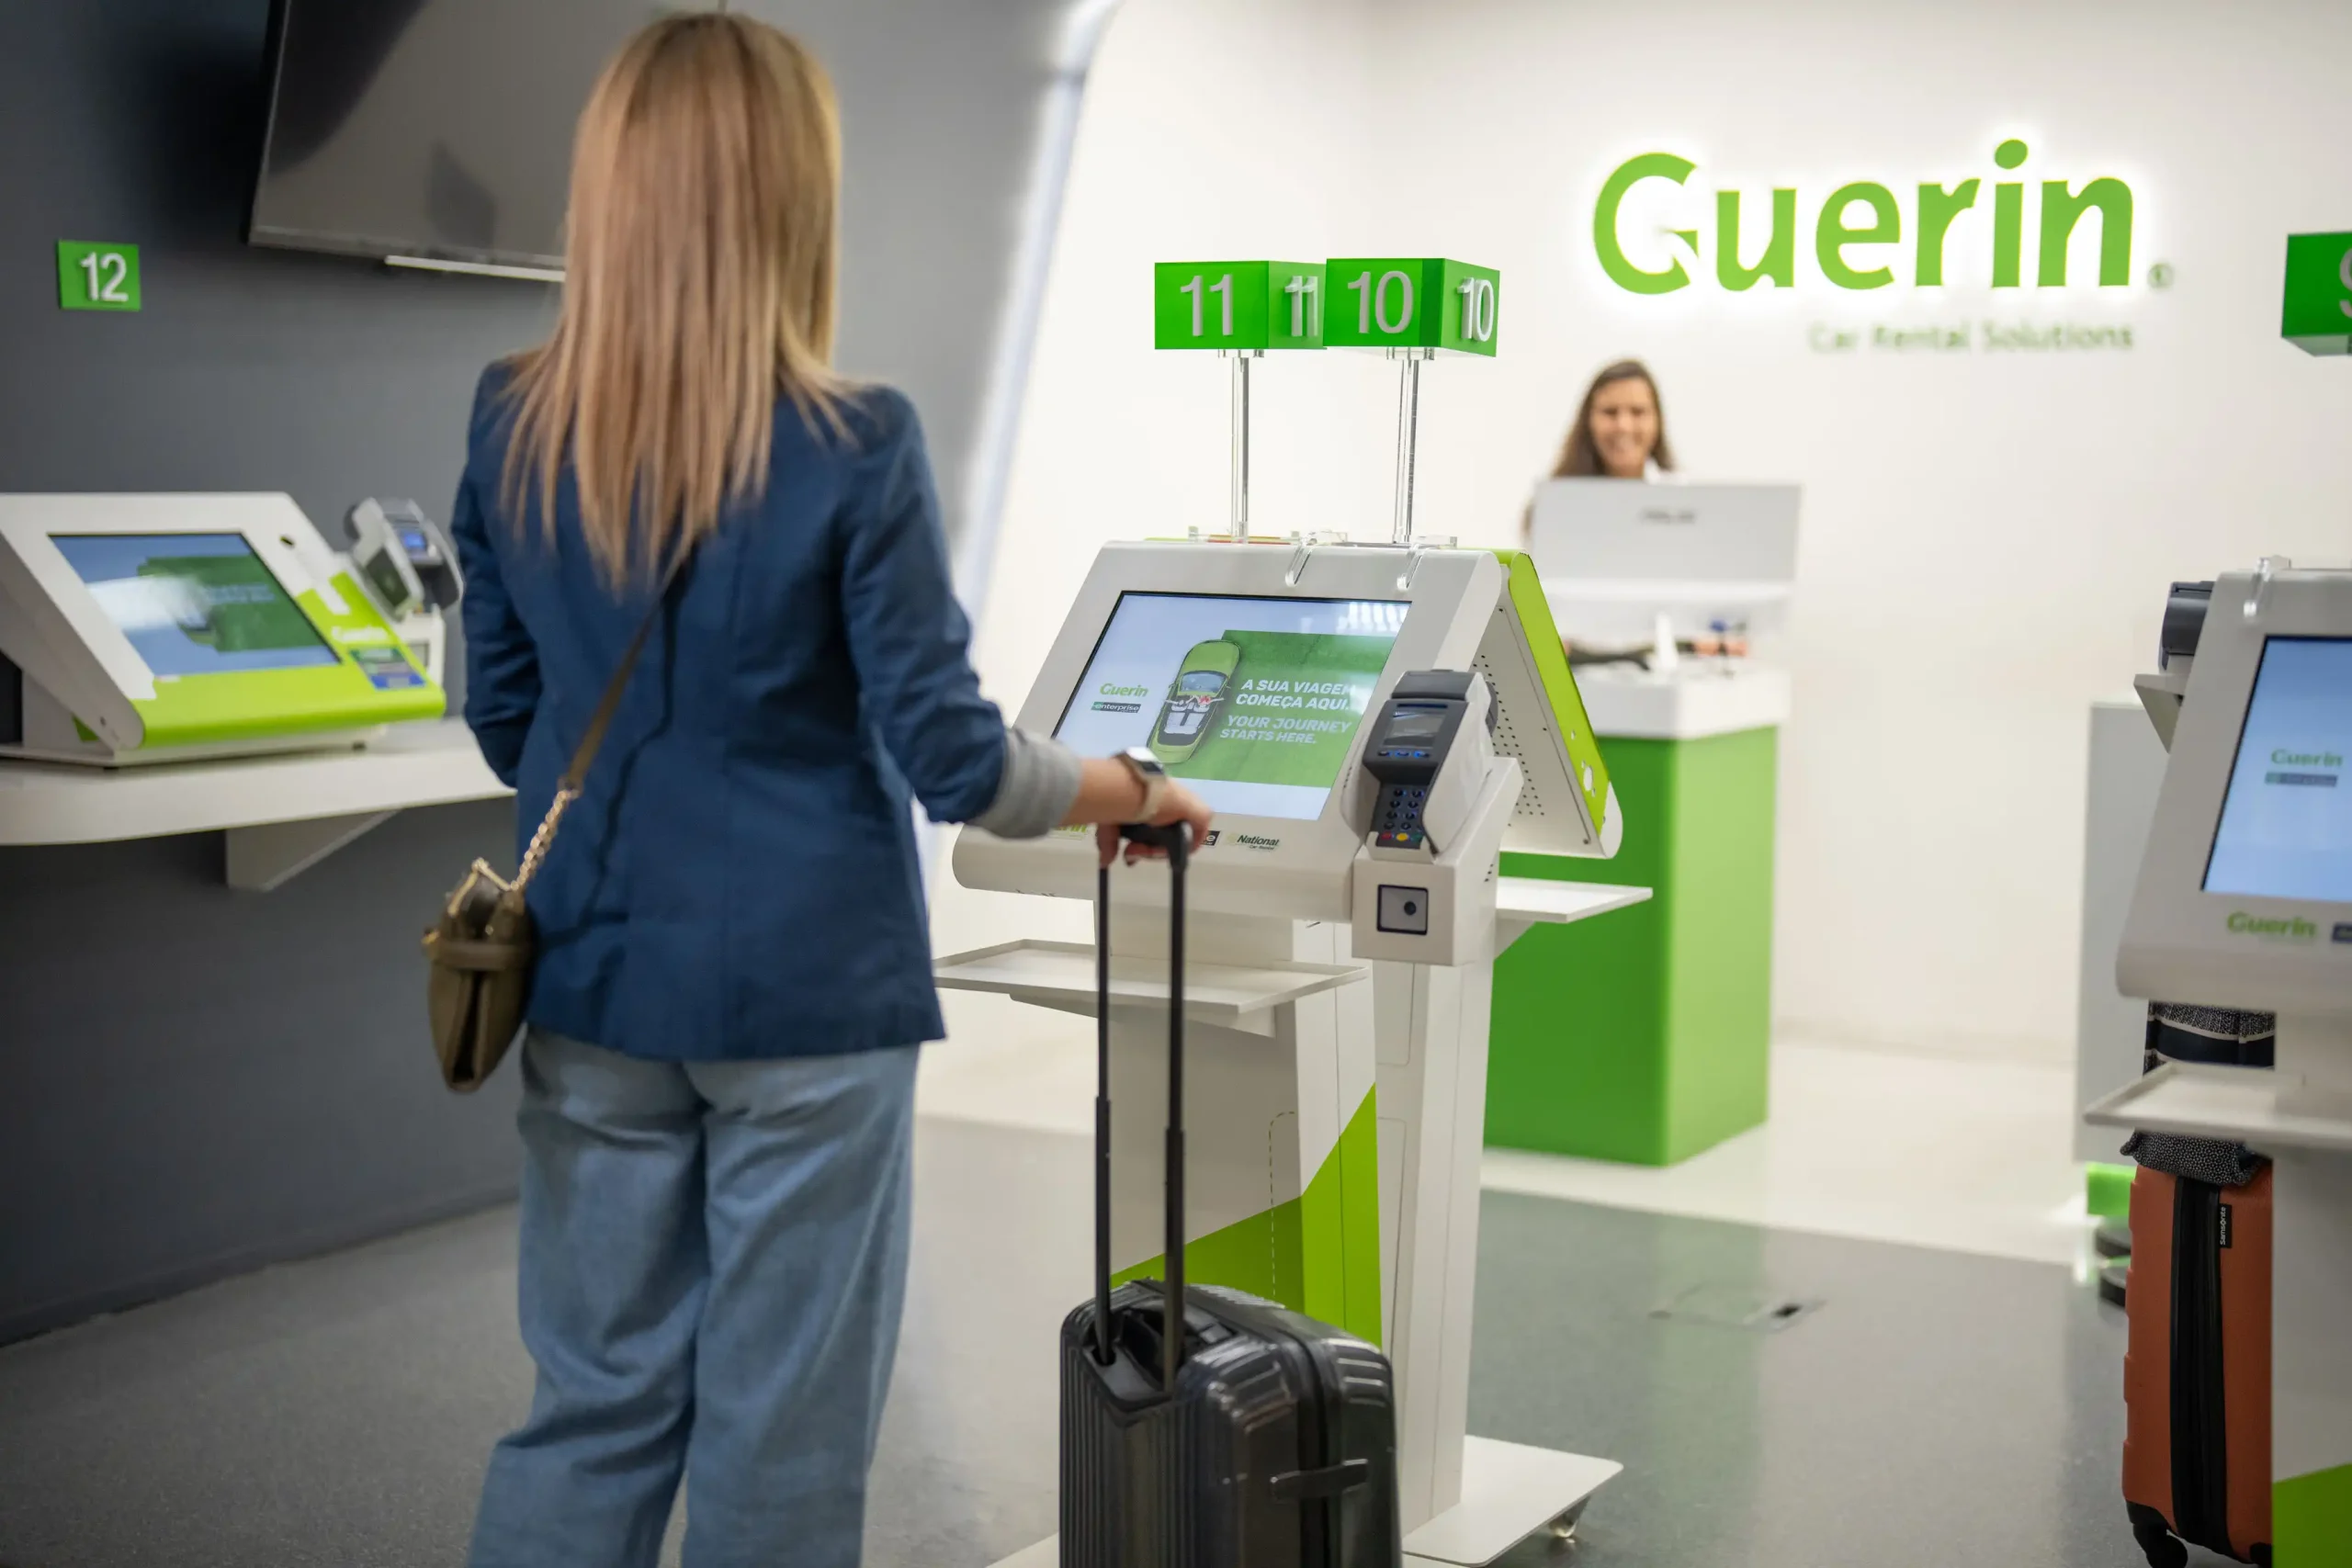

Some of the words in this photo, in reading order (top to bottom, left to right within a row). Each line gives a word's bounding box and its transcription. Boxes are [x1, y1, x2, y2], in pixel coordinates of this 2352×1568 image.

[1593, 139, 2133, 295] Guerin
[80, 252, 129, 301] 12
[1180, 274, 1234, 336] 11
[1284, 276, 1318, 337] 11
[1347, 270, 1414, 334] 10
[1457, 276, 1495, 343] 10
[1873, 321, 1969, 352] Rental
[1983, 321, 2133, 352] Solutions
[1100, 682, 1149, 697] Guerin
[1240, 679, 1253, 691] A
[1256, 680, 1289, 693] SUA
[1094, 704, 1139, 712] enterprise
[1236, 694, 1303, 708] COMEÇA
[1306, 697, 1350, 711] AQUI.
[1220, 728, 1274, 741] STARTS
[1275, 732, 1317, 744] HERE.
[1227, 715, 1269, 728] YOUR
[1272, 718, 1352, 733] JOURNEY
[1237, 834, 1280, 846] National
[2227, 911, 2317, 937] Guerin
